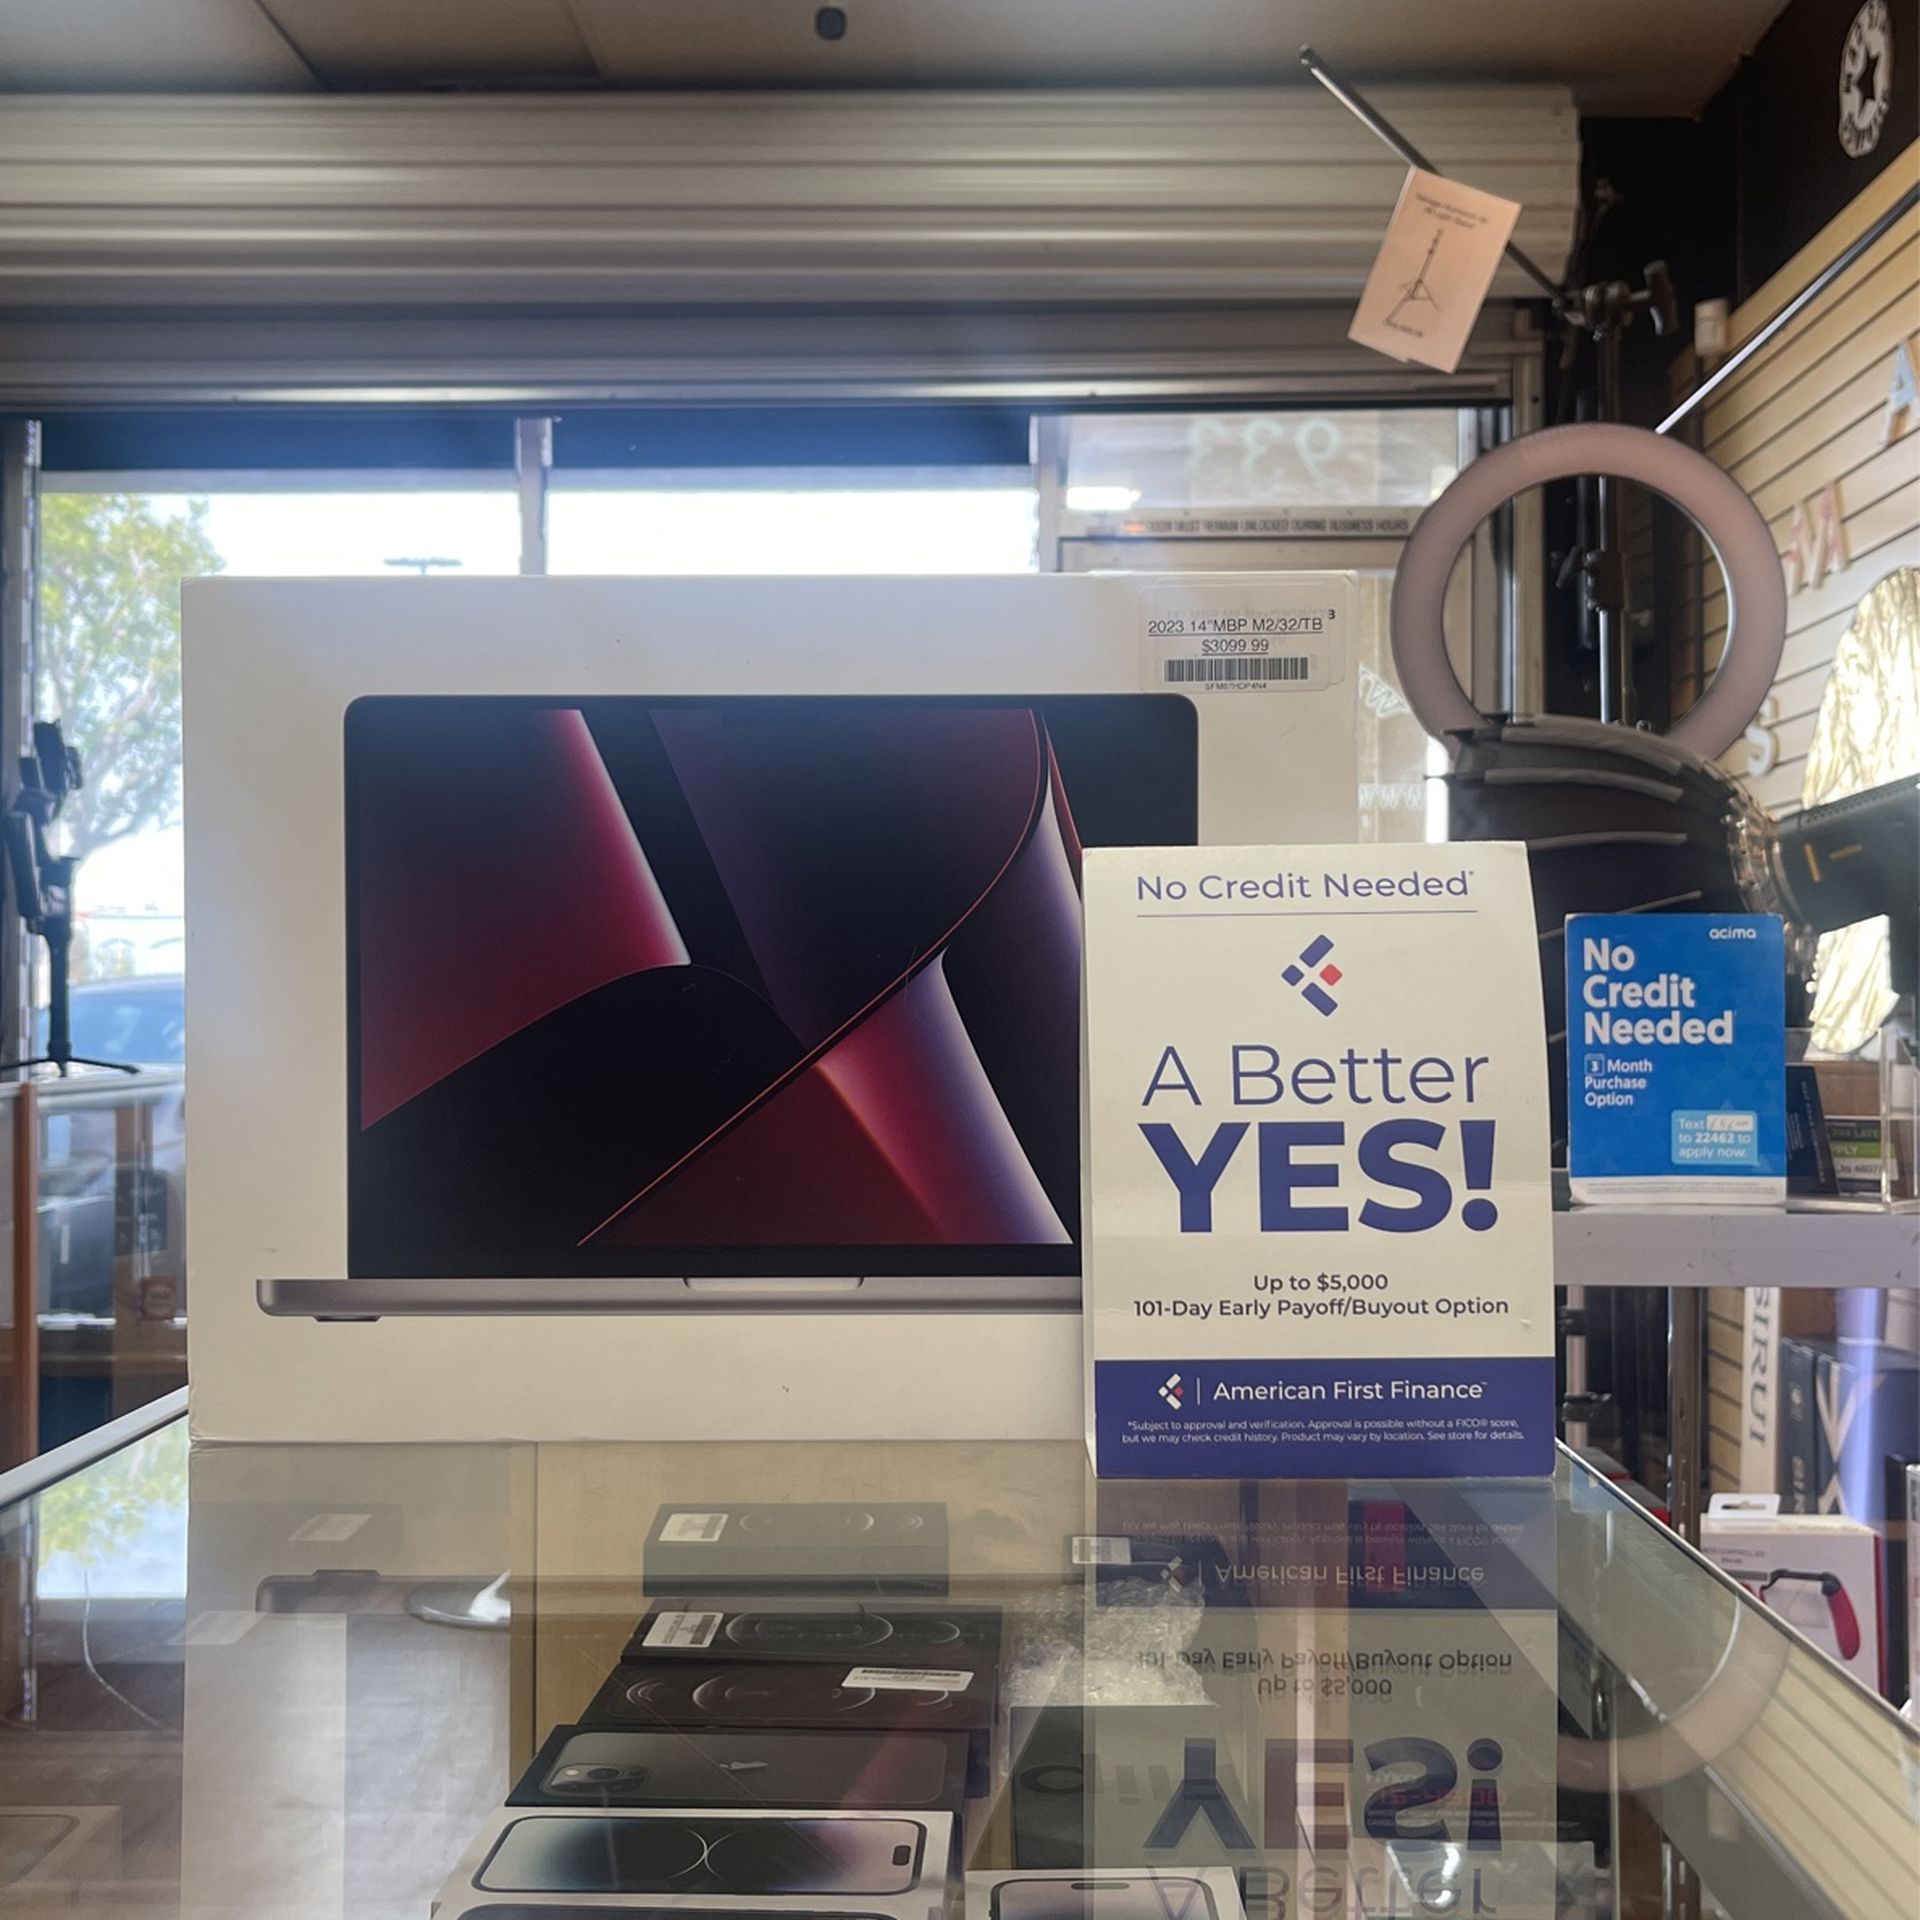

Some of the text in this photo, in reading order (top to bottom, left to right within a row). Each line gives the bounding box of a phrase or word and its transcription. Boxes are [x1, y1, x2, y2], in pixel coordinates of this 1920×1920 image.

[1148, 619, 1185, 634] 2023
[1252, 617, 1323, 632] M2/32/TB
[1201, 638, 1270, 653] $3099.99
[1137, 876, 1187, 901] No
[1199, 873, 1312, 899] Credit
[1708, 927, 1758, 940] acima
[1583, 938, 1636, 972] No
[1582, 973, 1696, 1008] Credit
[1607, 1057, 1653, 1073] Month
[1142, 1044, 1489, 1106] A Better
[1585, 1074, 1647, 1090] Purchase
[1585, 1092, 1634, 1109] Option
[1679, 1118, 1705, 1130] Text
[1679, 1132, 1751, 1144] to 22462 to
[1678, 1145, 1748, 1160] apply now.
[1137, 1118, 1498, 1233] YES!
[1253, 1273, 1388, 1294] Up to $5,000
[1134, 1297, 1509, 1320] 101-Day Early Payoff/Buyout Option
[1750, 1287, 1769, 1443] SIRUI
[1213, 1381, 1327, 1401] American
[1333, 1380, 1384, 1400] First
[1171, 1420, 1182, 1430] to
[1184, 1419, 1226, 1432] approval
[1228, 1419, 1247, 1430] and
[1250, 1418, 1305, 1430] verification.
[1307, 1418, 1352, 1430] Approval
[1354, 1418, 1362, 1428] is
[1364, 1418, 1404, 1430] possible
[1406, 1417, 1445, 1428] without
[1447, 1419, 1453, 1428] a
[1490, 1417, 1519, 1430] score,
[1122, 1429, 1525, 1445] but we may check credit history. Product may vary by location. See store for details.
